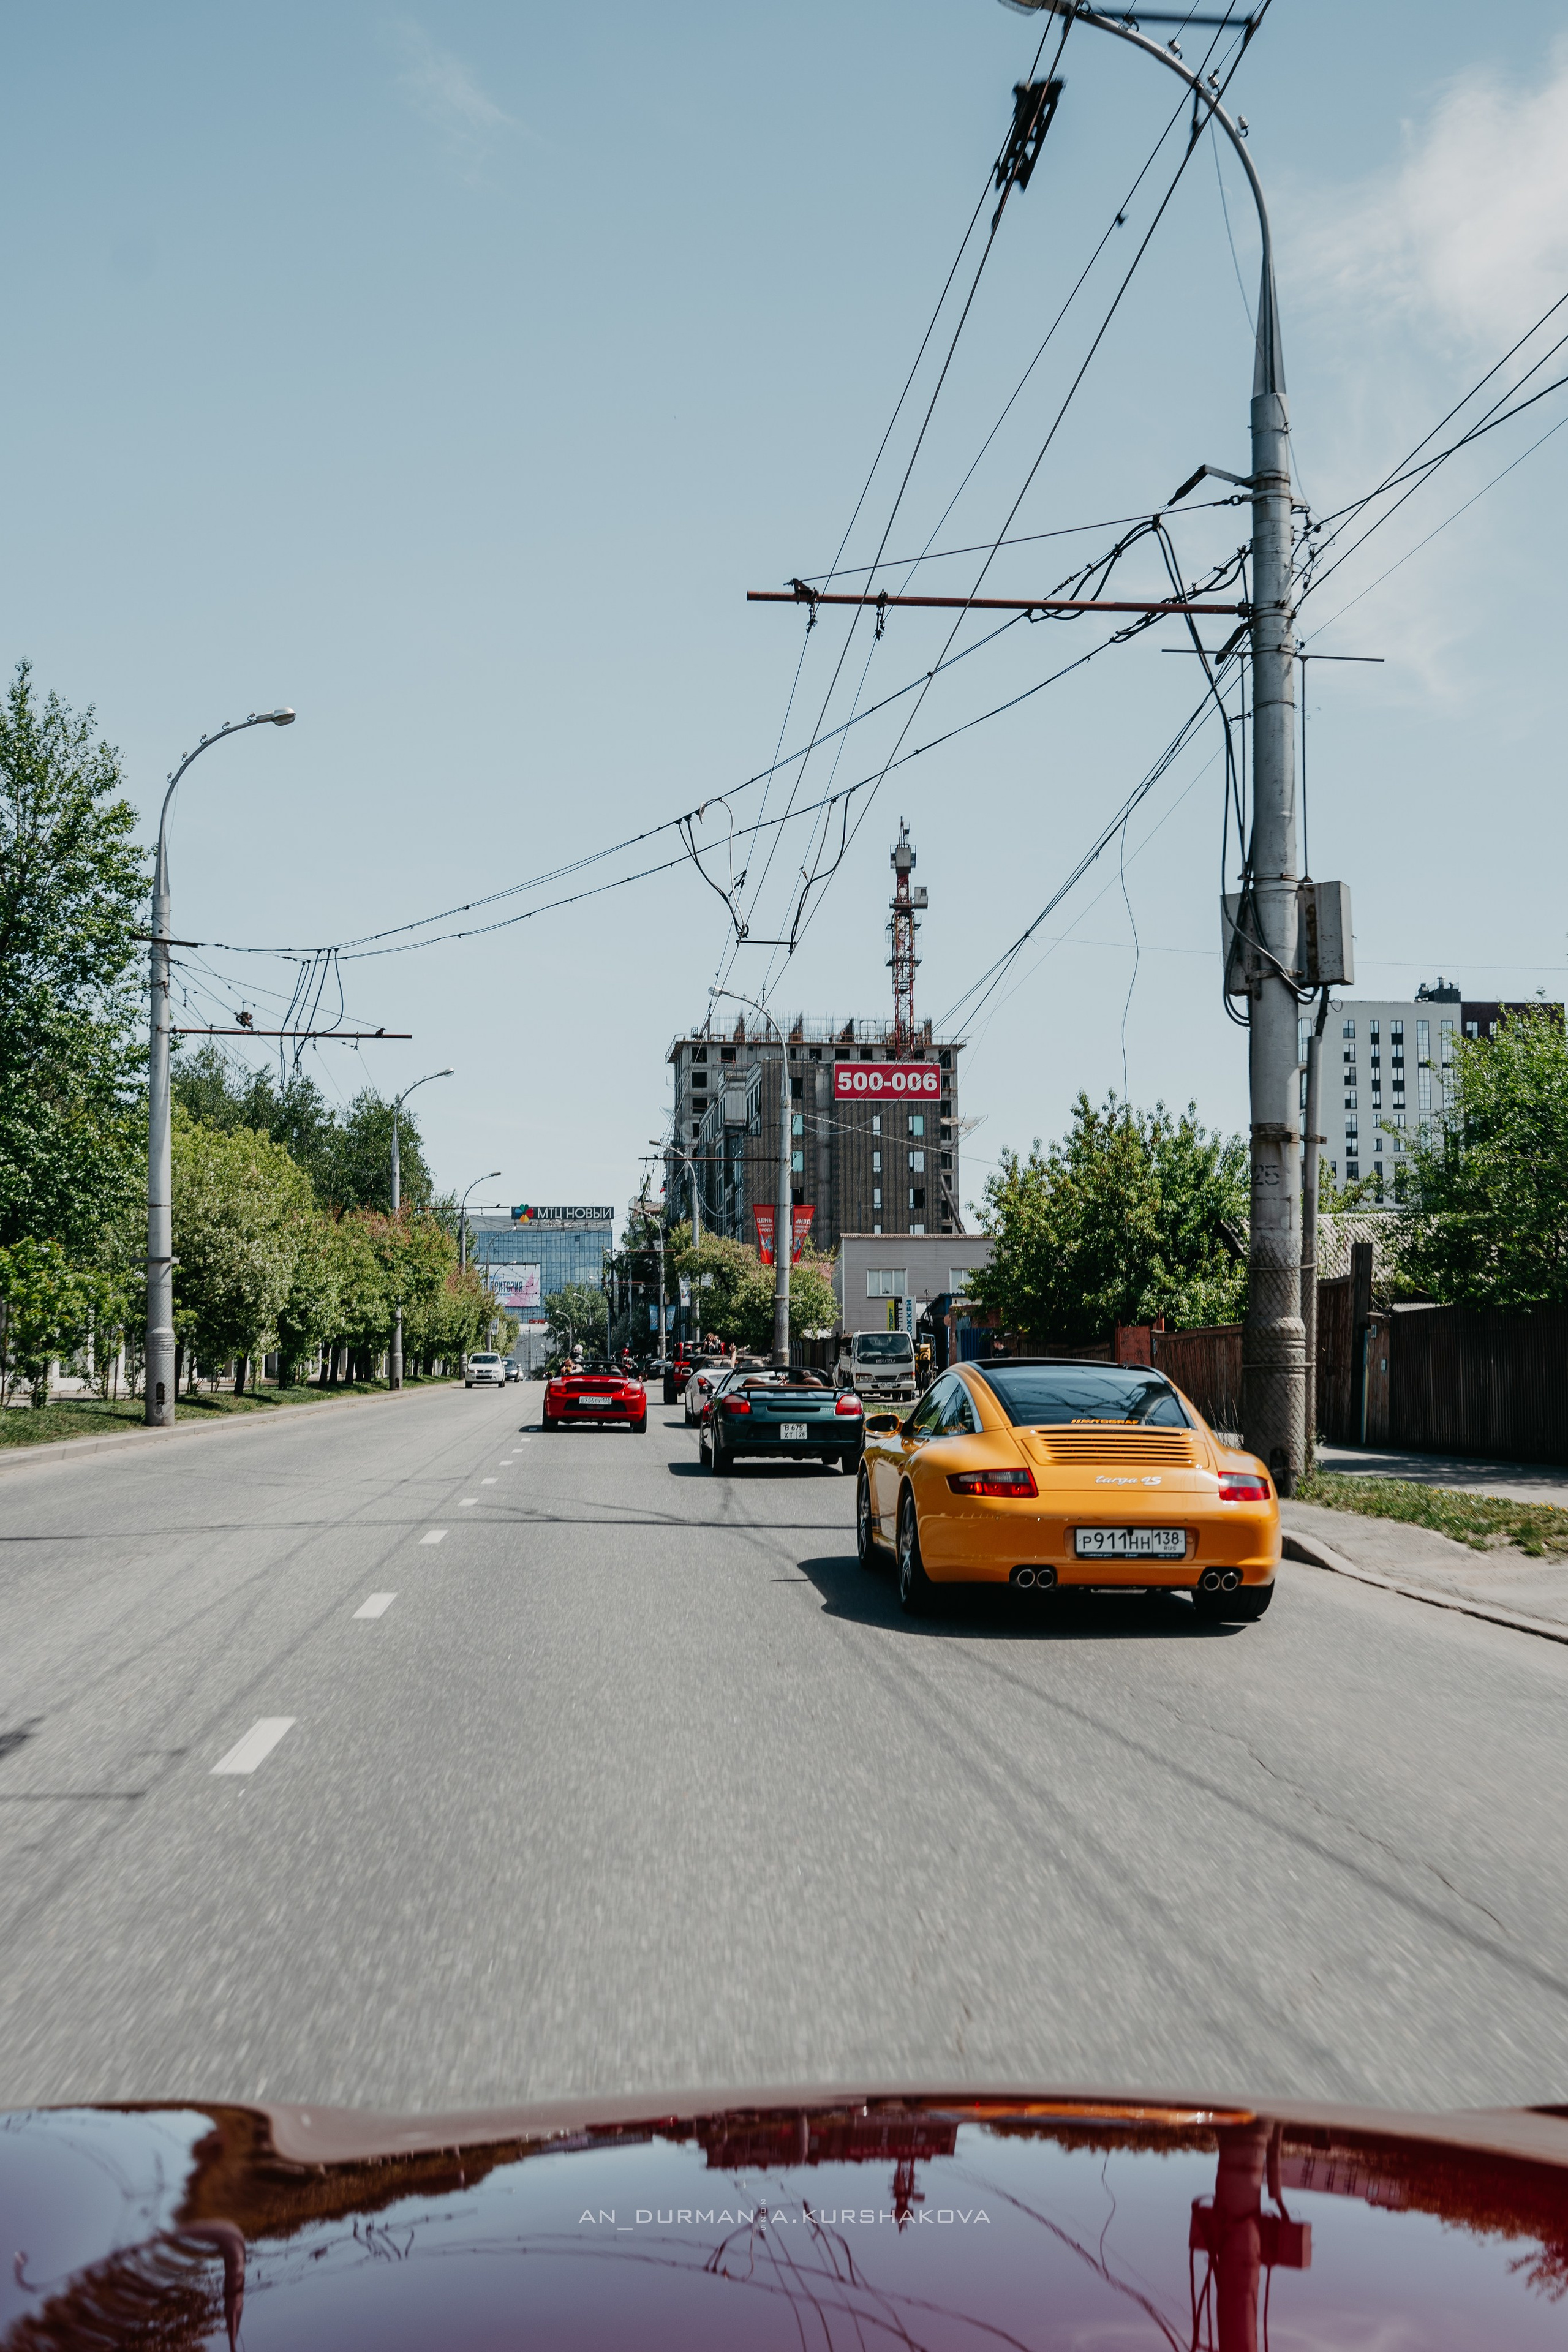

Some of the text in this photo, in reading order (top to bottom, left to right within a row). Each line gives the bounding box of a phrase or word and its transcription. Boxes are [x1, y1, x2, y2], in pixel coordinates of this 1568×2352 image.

[837, 1071, 938, 1091] 500-006
[537, 1207, 562, 1219] МТЦ
[1140, 1476, 1162, 1486] 4S
[1154, 1531, 1179, 1545] 138
